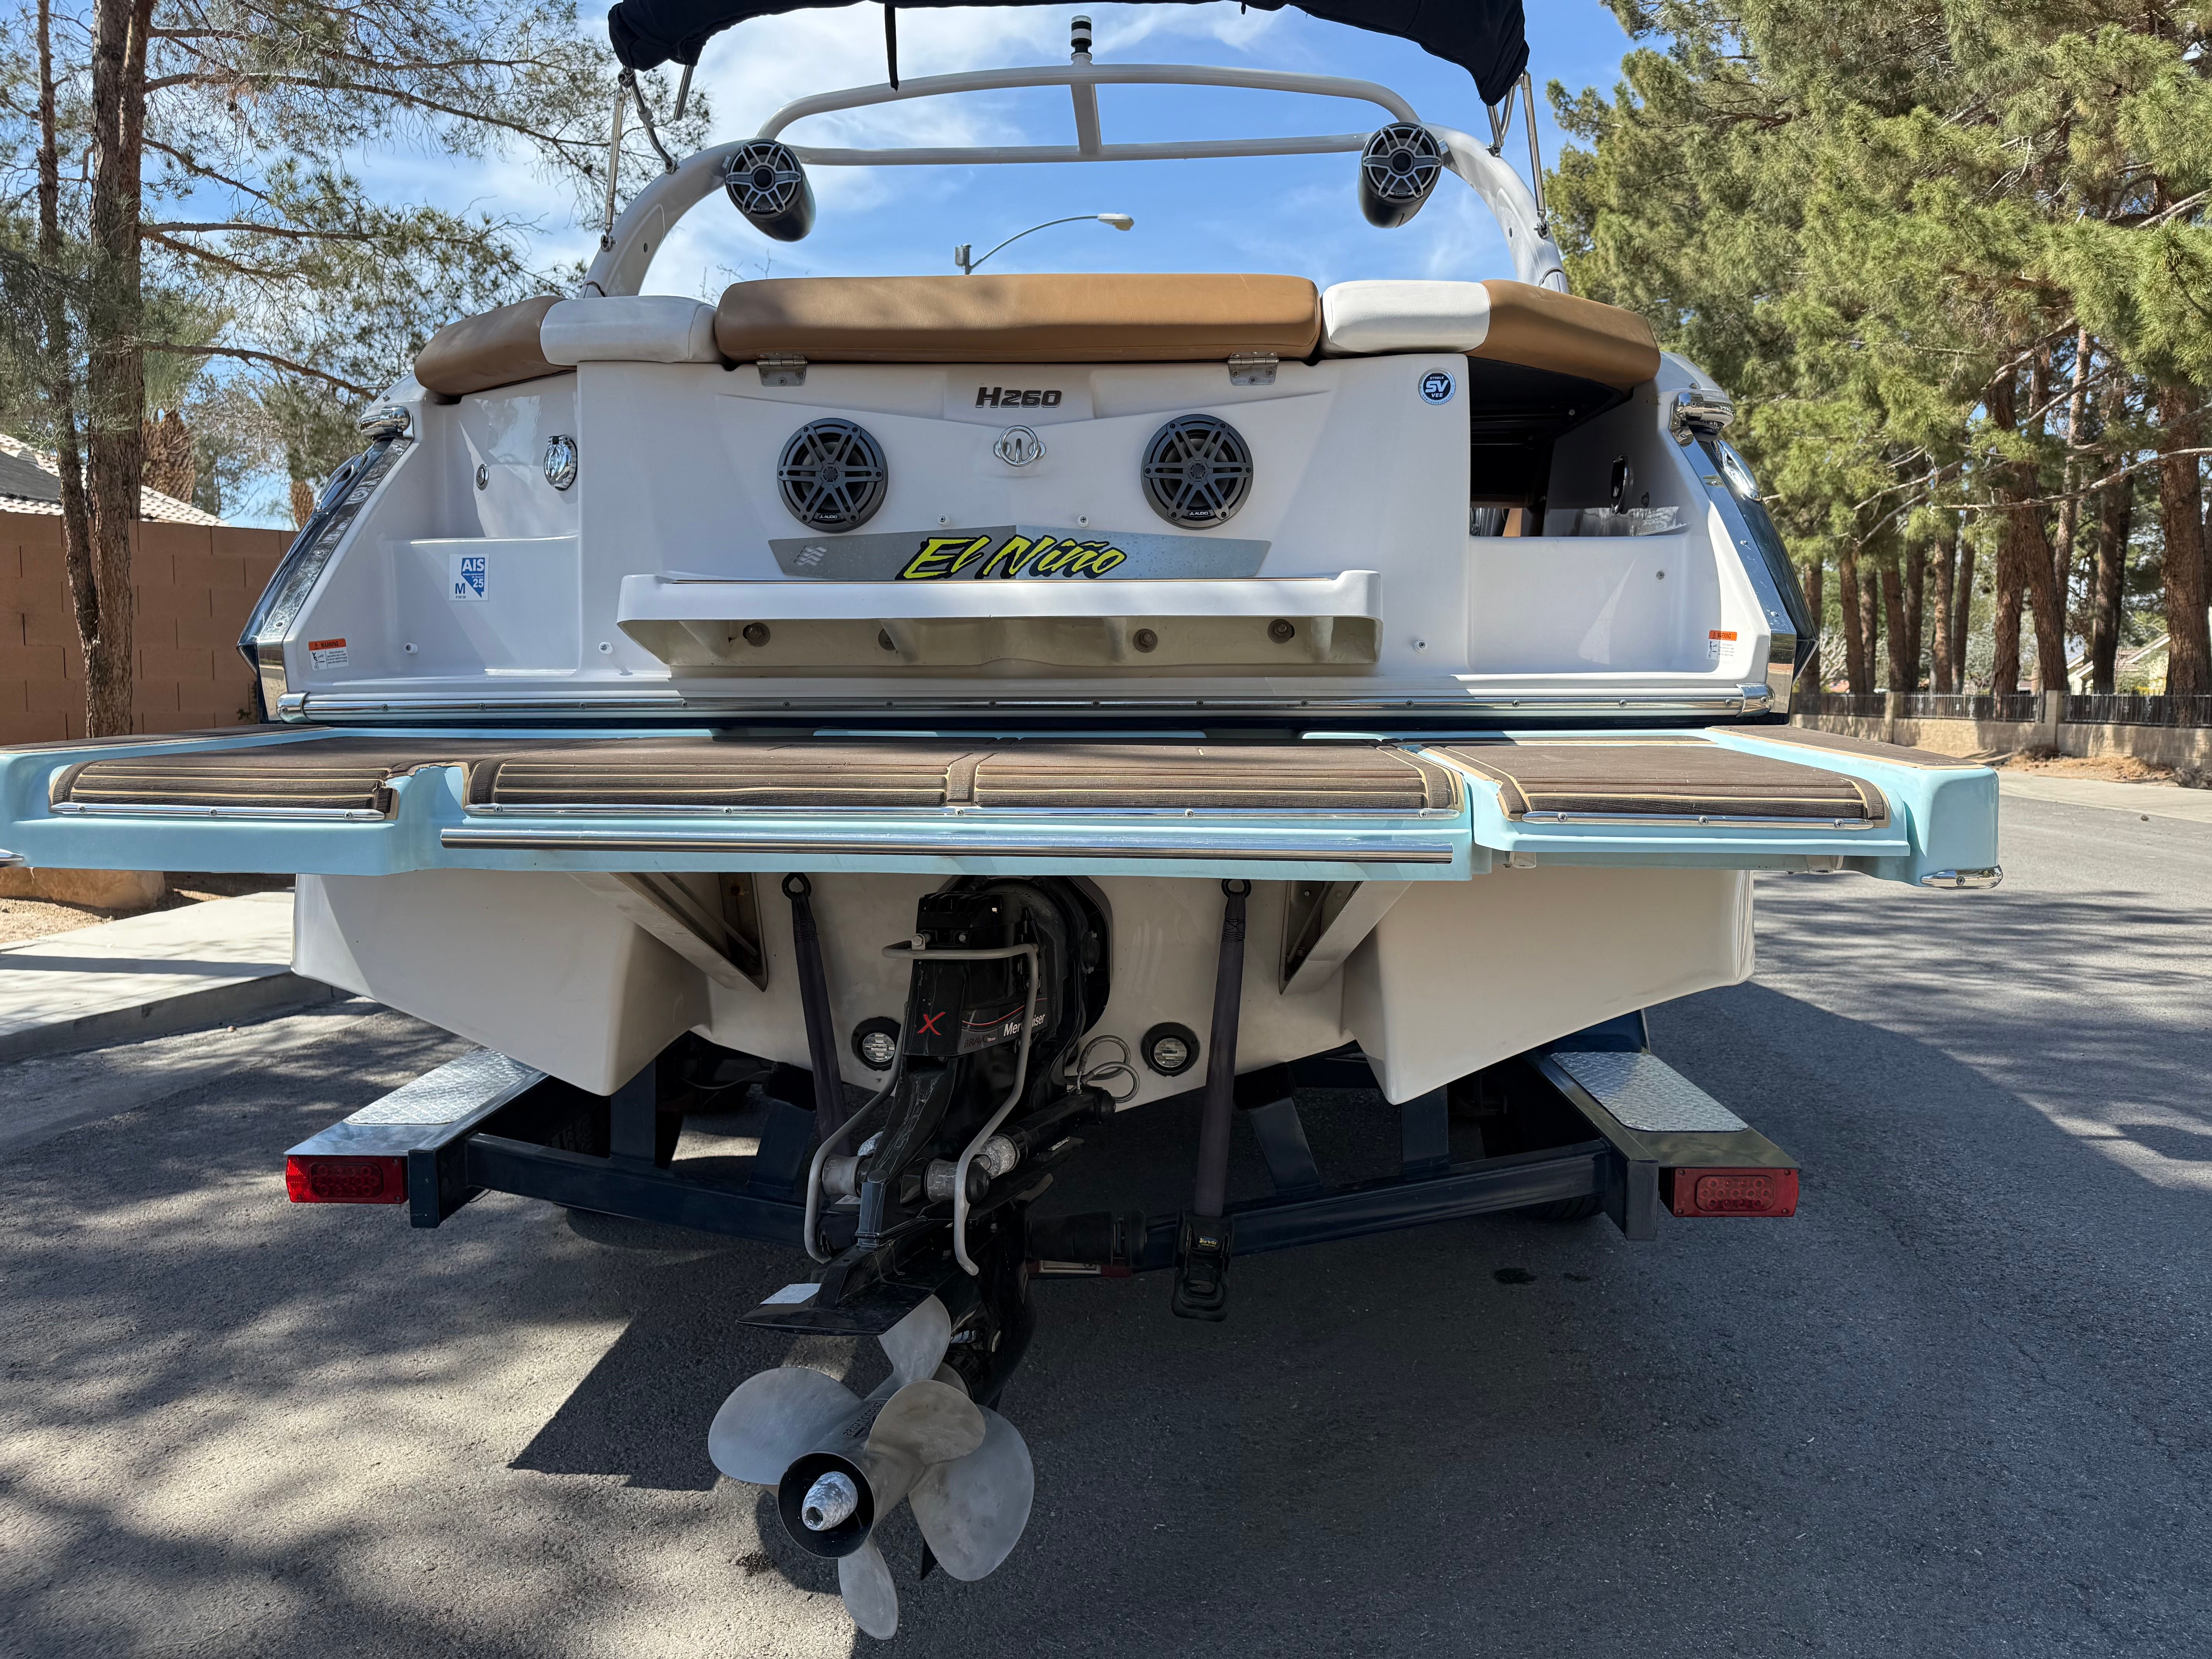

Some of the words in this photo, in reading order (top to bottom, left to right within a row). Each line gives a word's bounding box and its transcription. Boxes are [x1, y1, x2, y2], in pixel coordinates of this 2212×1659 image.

[1425, 380, 1449, 393] SV
[975, 387, 1062, 408] H260
[900, 535, 992, 580] El
[979, 536, 1127, 578] Niño
[462, 558, 484, 572] AIS
[455, 583, 465, 594] M
[473, 579, 484, 587] 25
